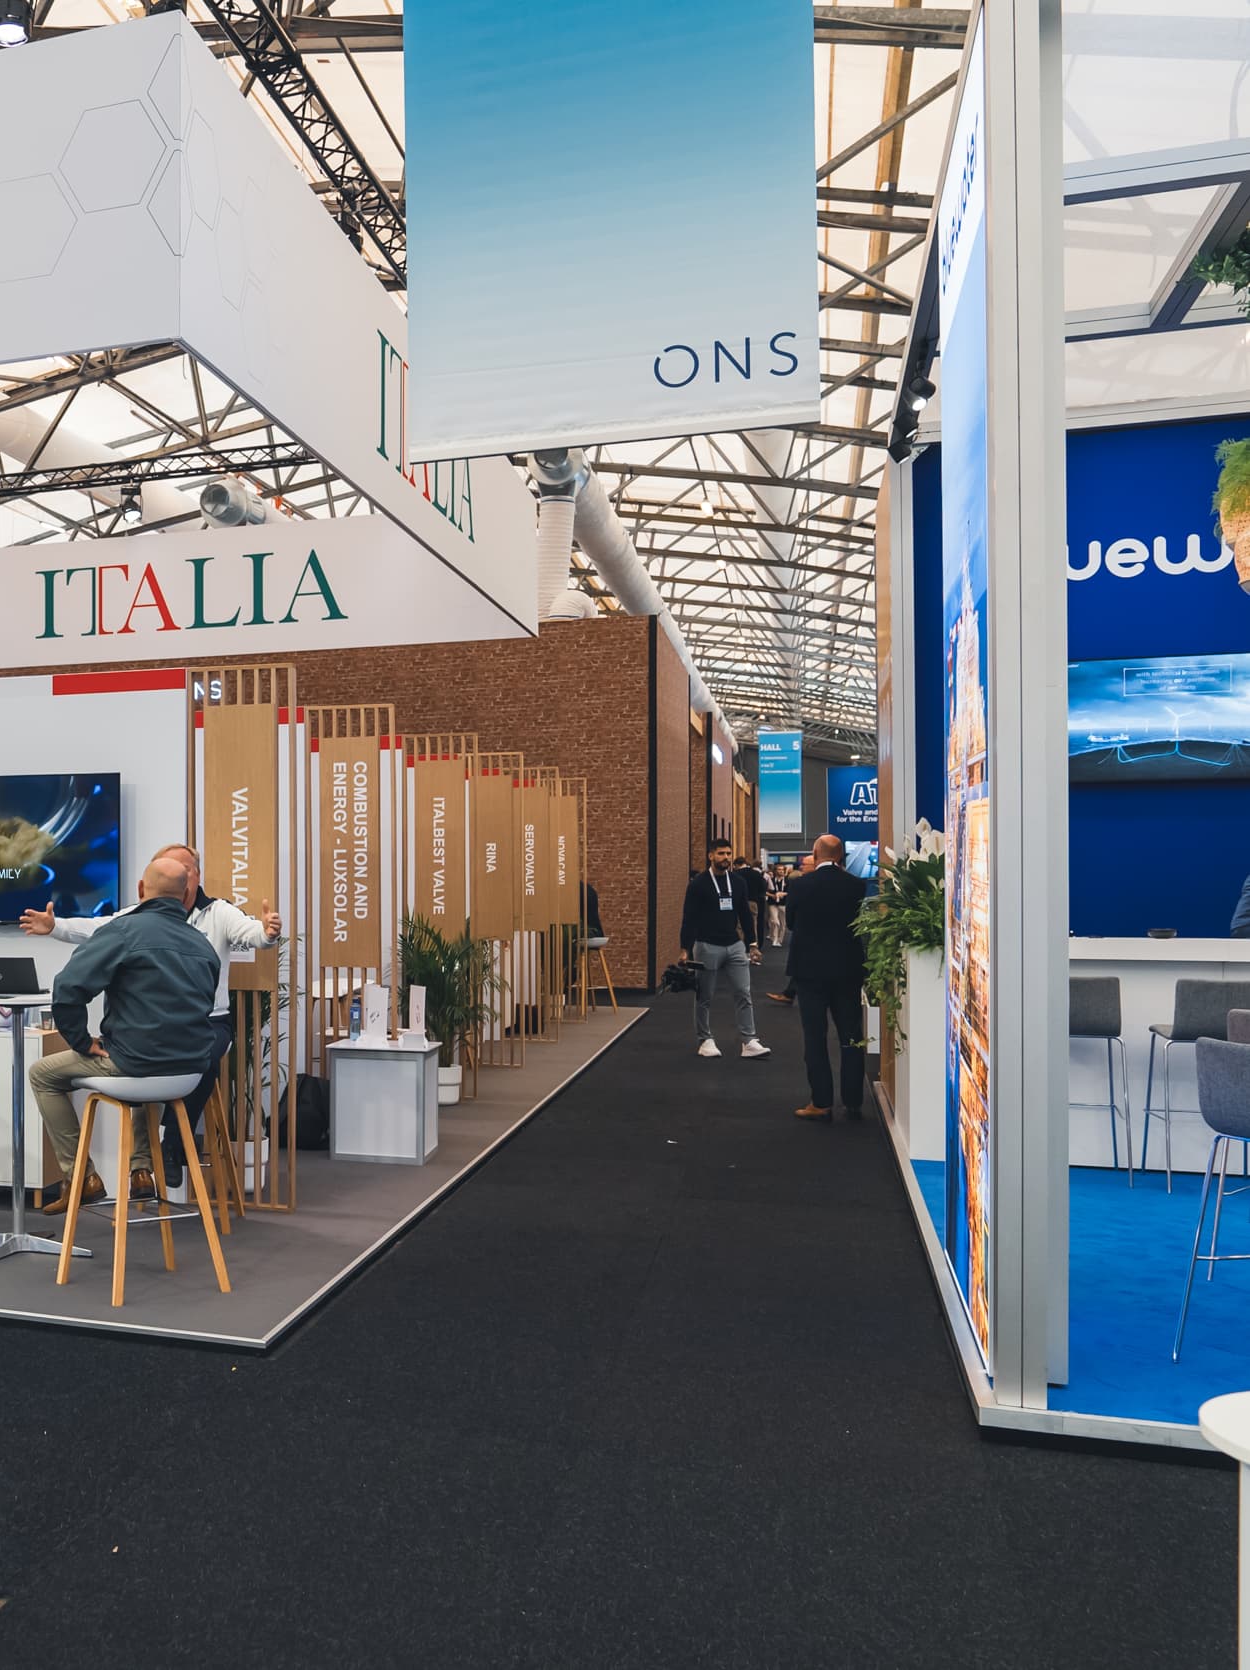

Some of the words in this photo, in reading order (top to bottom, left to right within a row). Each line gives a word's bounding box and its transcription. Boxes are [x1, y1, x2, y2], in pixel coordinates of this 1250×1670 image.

[654, 332, 799, 388] ONS
[35, 549, 349, 639] ITALIA
[760, 743, 782, 751] HALL
[792, 740, 800, 750] 5
[333, 762, 347, 834] ENERGY
[353, 761, 367, 878] COMBUSTION
[433, 797, 445, 865] ITALBEST
[232, 787, 248, 911] VALVITALIA
[486, 842, 496, 873] RINA
[525, 824, 535, 895] SERVOVALVE
[333, 849, 348, 942] LUXSOLAR
[353, 882, 367, 920] AND
[433, 869, 445, 915] VALVE
